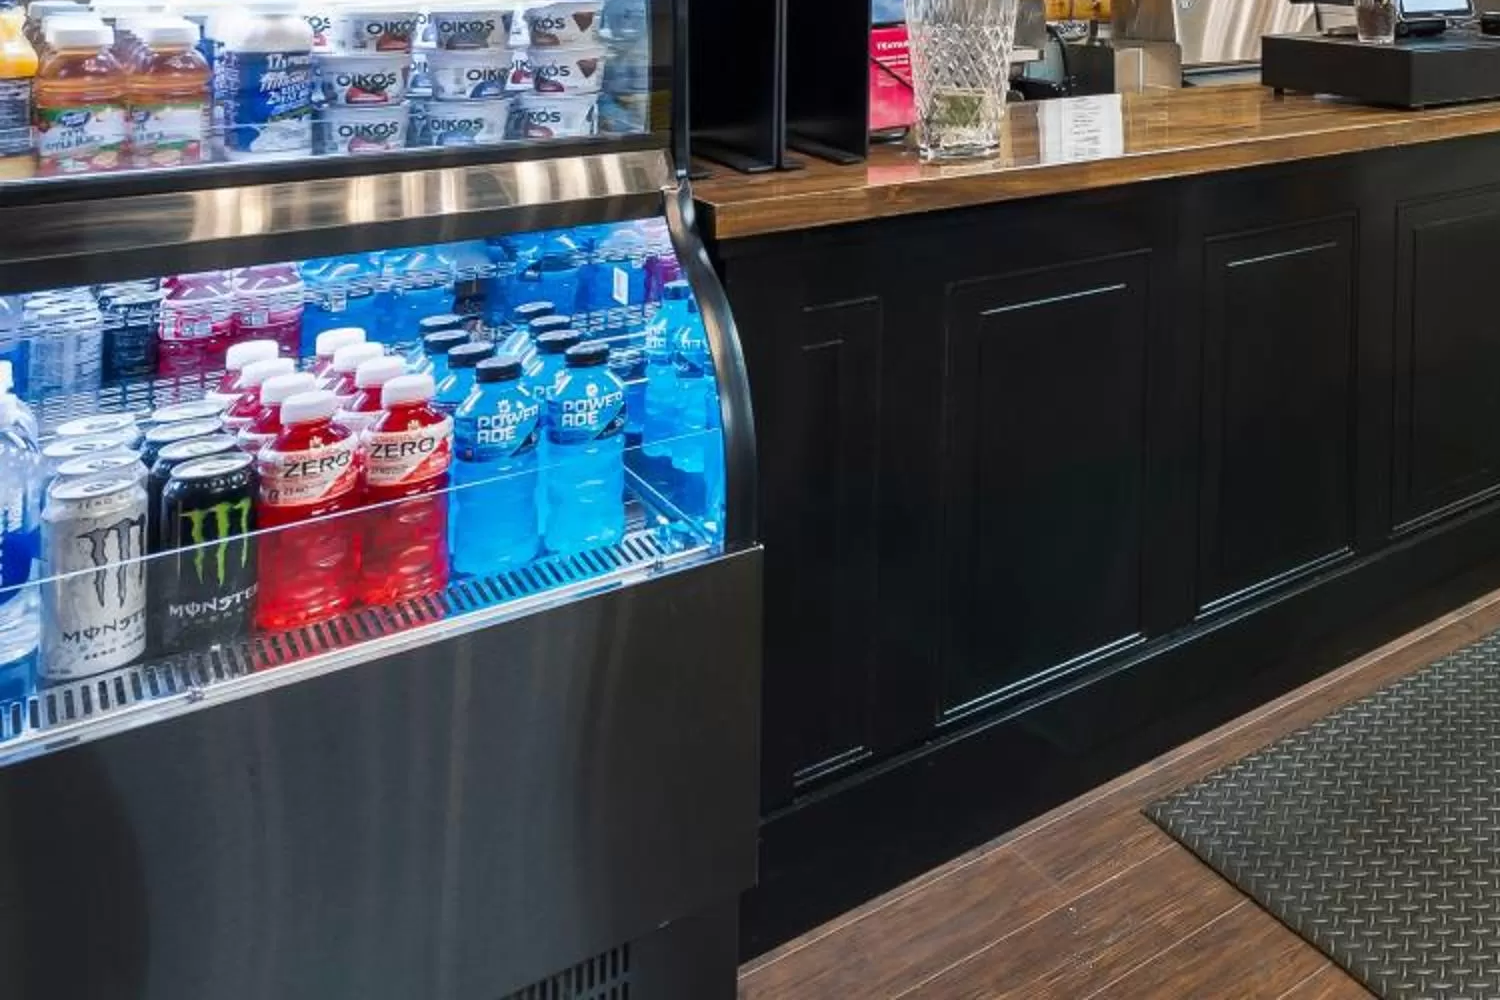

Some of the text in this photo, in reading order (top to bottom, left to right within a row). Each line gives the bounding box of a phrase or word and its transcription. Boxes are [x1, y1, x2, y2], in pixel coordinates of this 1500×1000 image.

[439, 18, 495, 34] OIKOS
[336, 69, 397, 92] OIKOS
[338, 120, 399, 139] OIKOS
[371, 437, 435, 459] ZERO
[284, 450, 351, 478] ZERO
